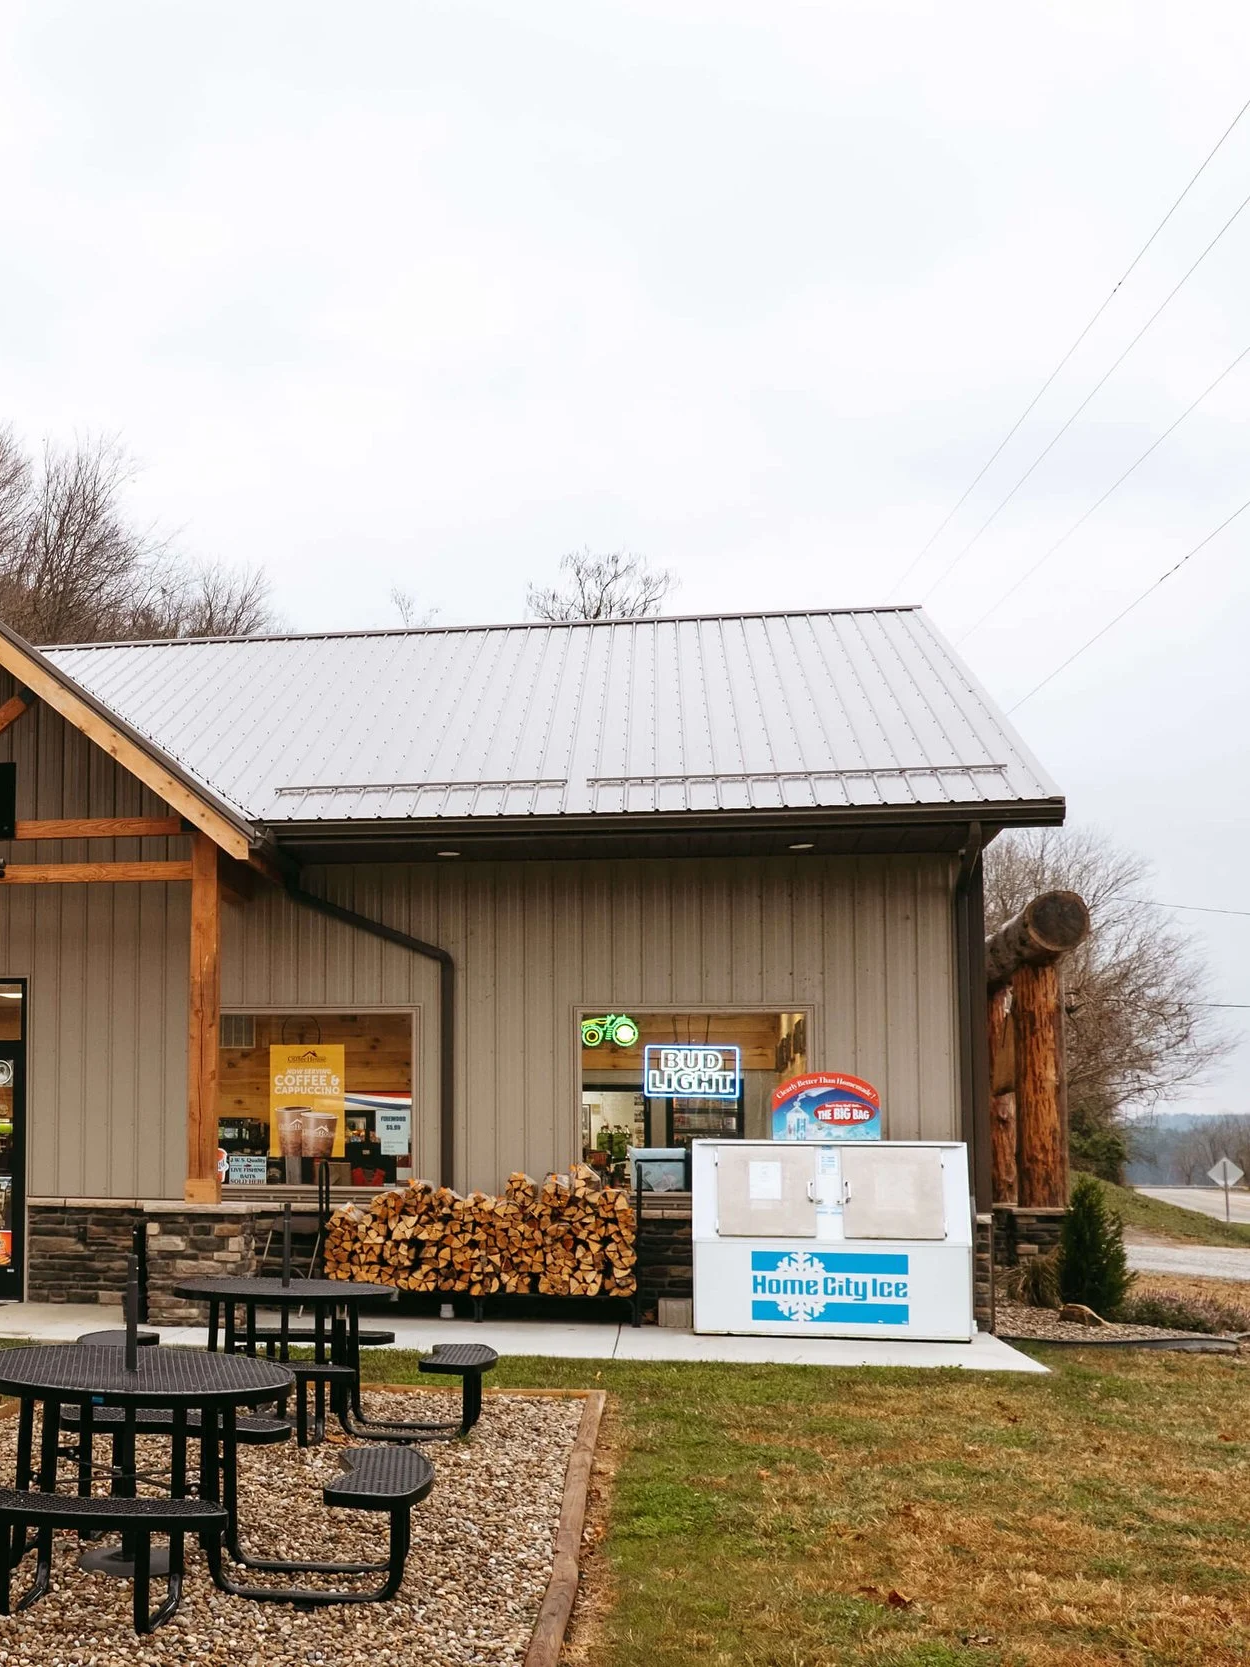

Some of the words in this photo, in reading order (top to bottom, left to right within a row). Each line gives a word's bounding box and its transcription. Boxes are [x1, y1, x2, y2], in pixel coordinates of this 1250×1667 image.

[660, 1049, 723, 1071] BUD
[274, 1074, 327, 1086] COFFEE
[331, 1074, 340, 1086] &
[776, 1083, 798, 1099] Clearly
[797, 1079, 818, 1088] Better
[819, 1076, 836, 1085] Than
[274, 1086, 340, 1095] CAPPUCCINO
[817, 1110, 832, 1120] THE
[833, 1108, 851, 1120] BIG
[852, 1109, 870, 1120] BAG
[752, 1275, 819, 1296] Home
[823, 1276, 868, 1302] City
[871, 1278, 908, 1298] Ice
